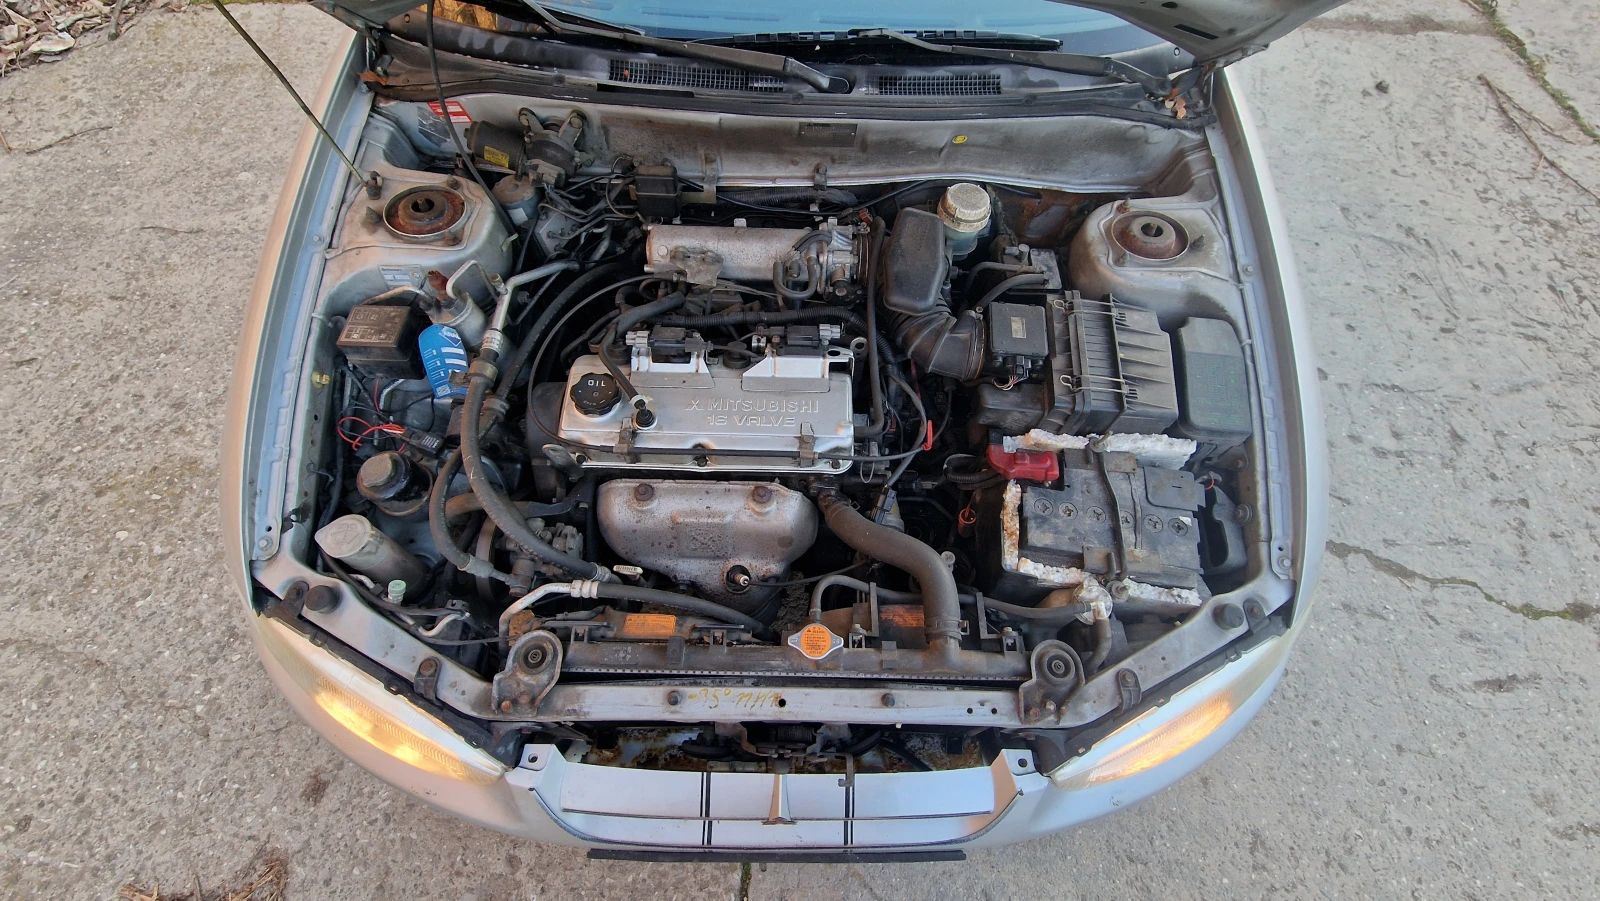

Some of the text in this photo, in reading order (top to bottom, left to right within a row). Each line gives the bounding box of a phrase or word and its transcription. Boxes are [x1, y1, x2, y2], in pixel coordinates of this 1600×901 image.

[587, 379, 606, 387] OIL
[707, 398, 819, 413] MITSUBISHI
[707, 414, 796, 427] 16 VALVE
